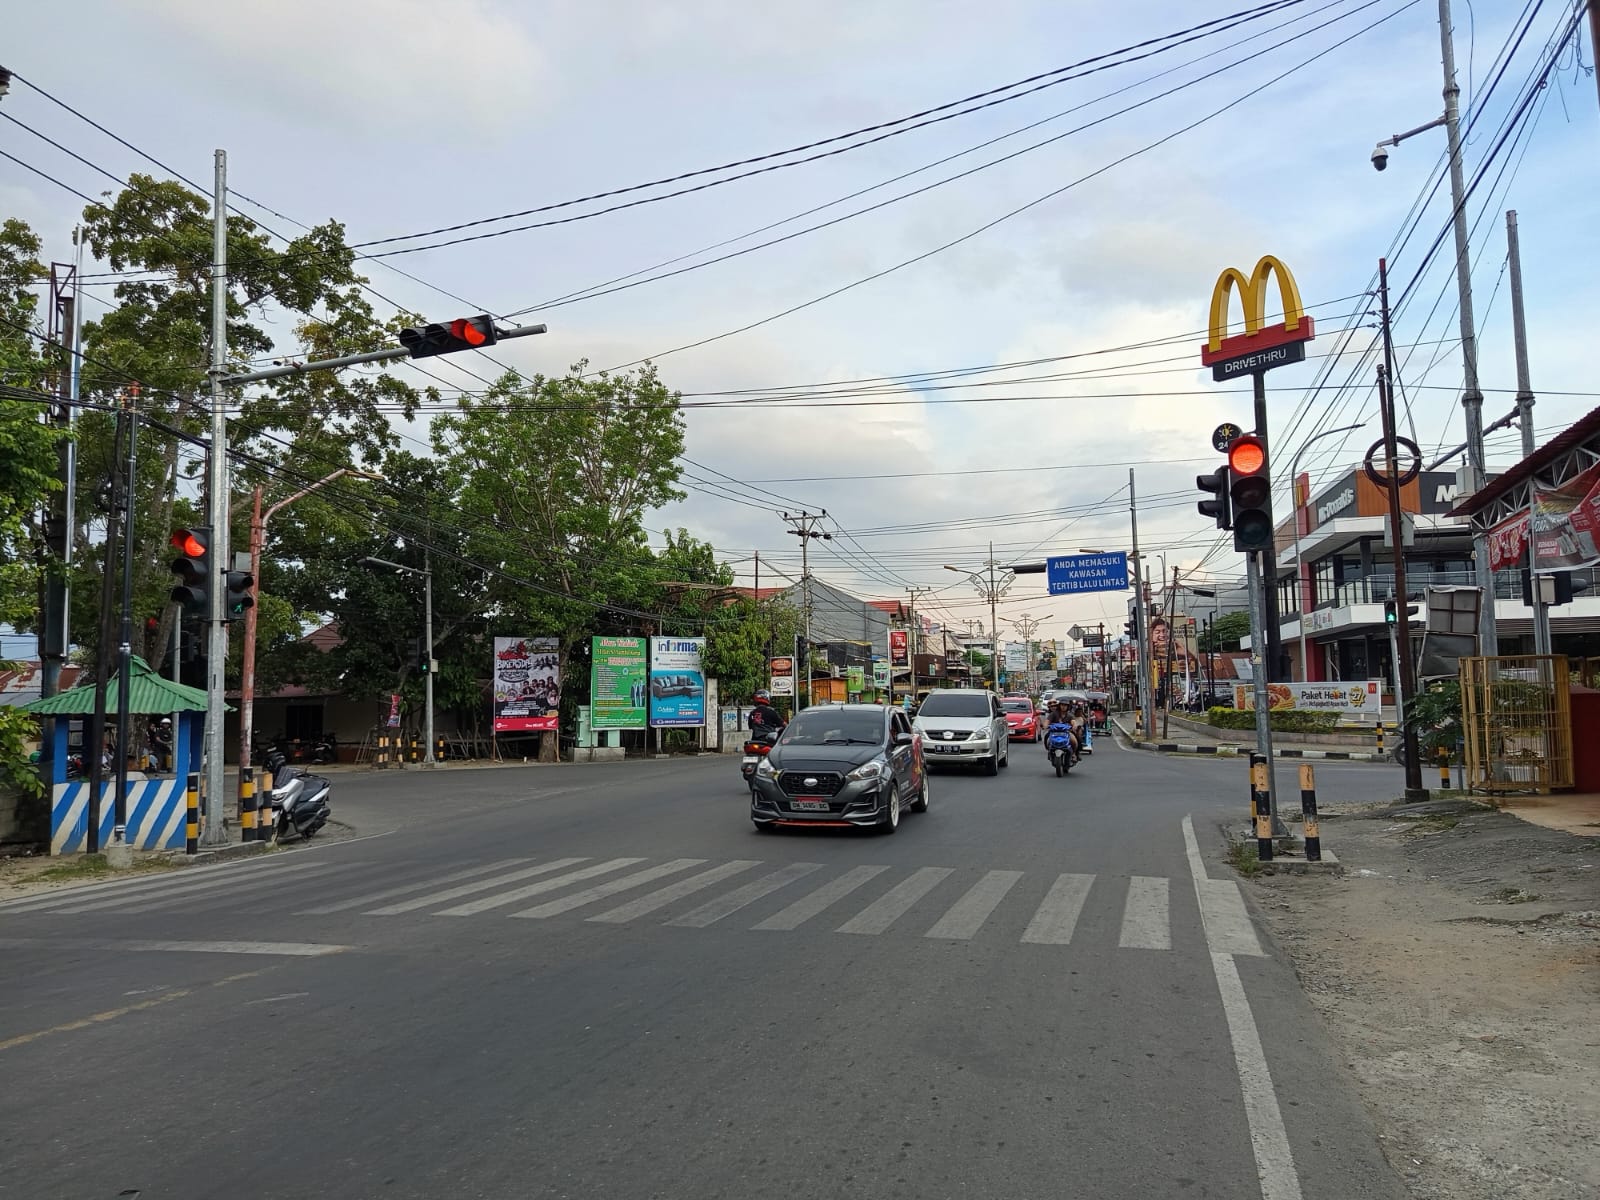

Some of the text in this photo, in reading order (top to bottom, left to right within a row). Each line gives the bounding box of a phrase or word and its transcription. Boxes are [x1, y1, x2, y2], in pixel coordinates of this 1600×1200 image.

[1054, 556, 1120, 570] ANDA MEMASUKI
[1068, 568, 1107, 579] KAWASAN
[1052, 577, 1125, 591] TERTIB LALU LINTAS
[658, 640, 698, 652] informa
[1301, 690, 1322, 700] Paket
